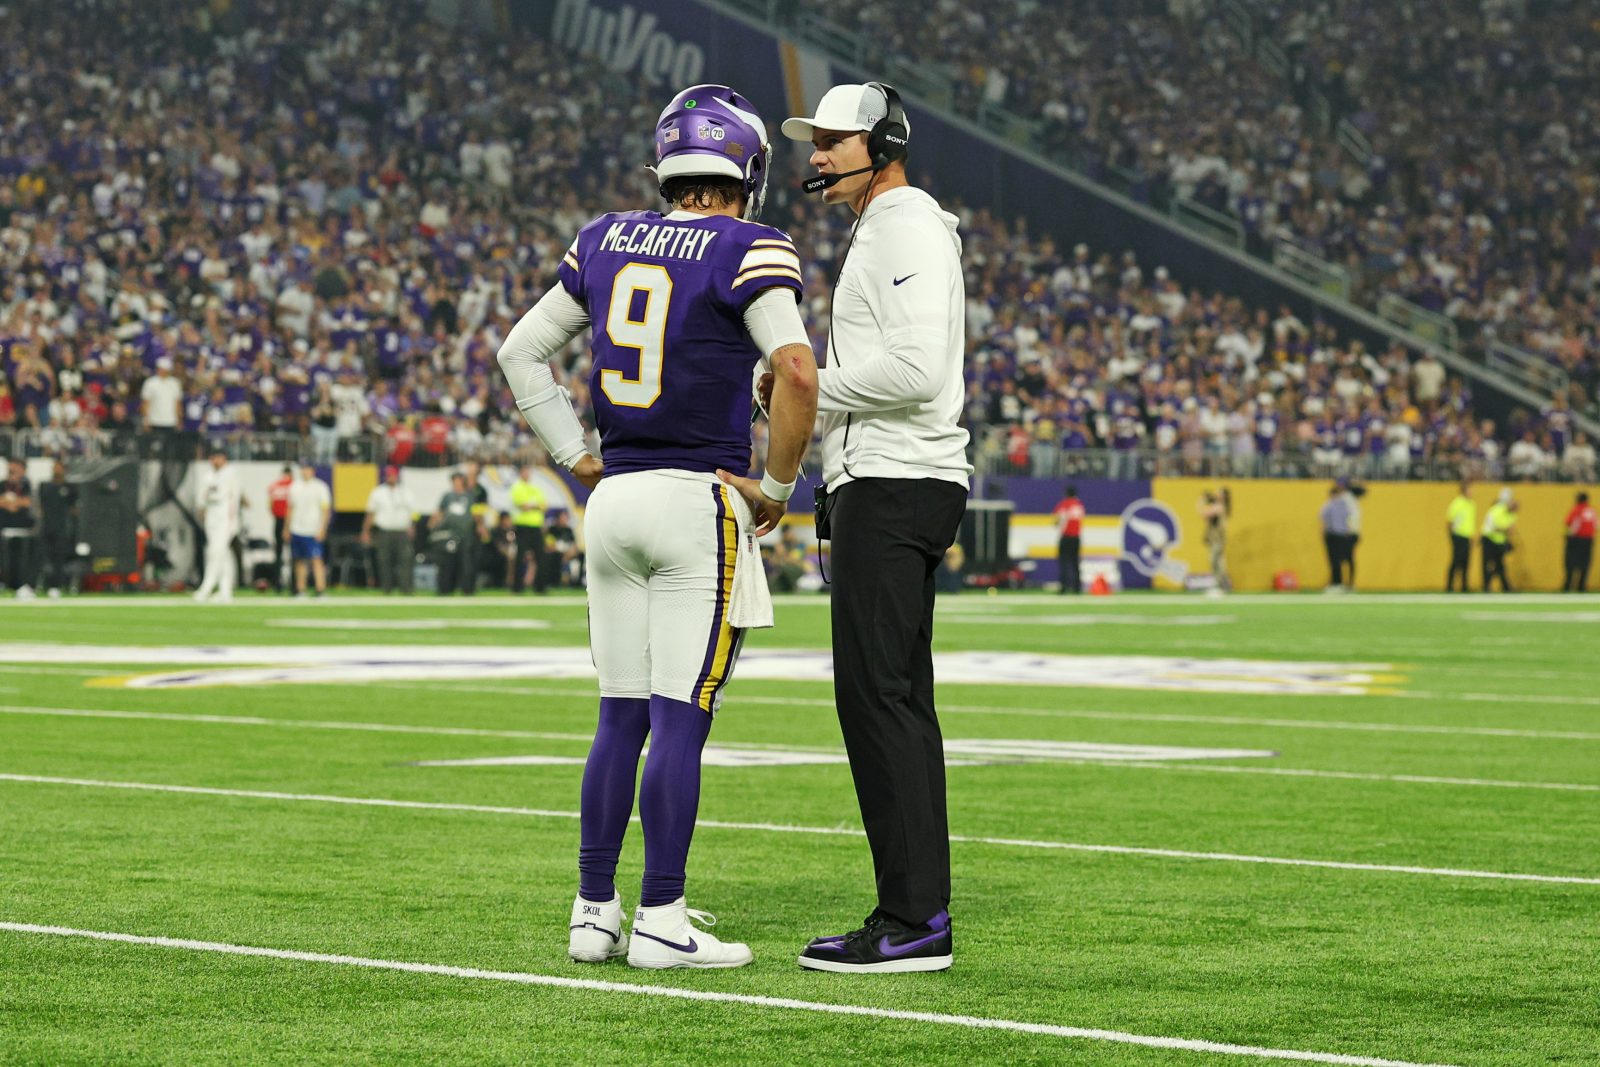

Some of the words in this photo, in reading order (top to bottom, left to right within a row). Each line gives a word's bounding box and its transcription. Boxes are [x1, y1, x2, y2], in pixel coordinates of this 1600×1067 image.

[713, 129, 723, 138] 70
[885, 134, 908, 145] SONY
[807, 179, 826, 190] SONY
[600, 222, 717, 261] McCARTHY
[601, 262, 673, 408] 9
[582, 905, 602, 917] SKOL
